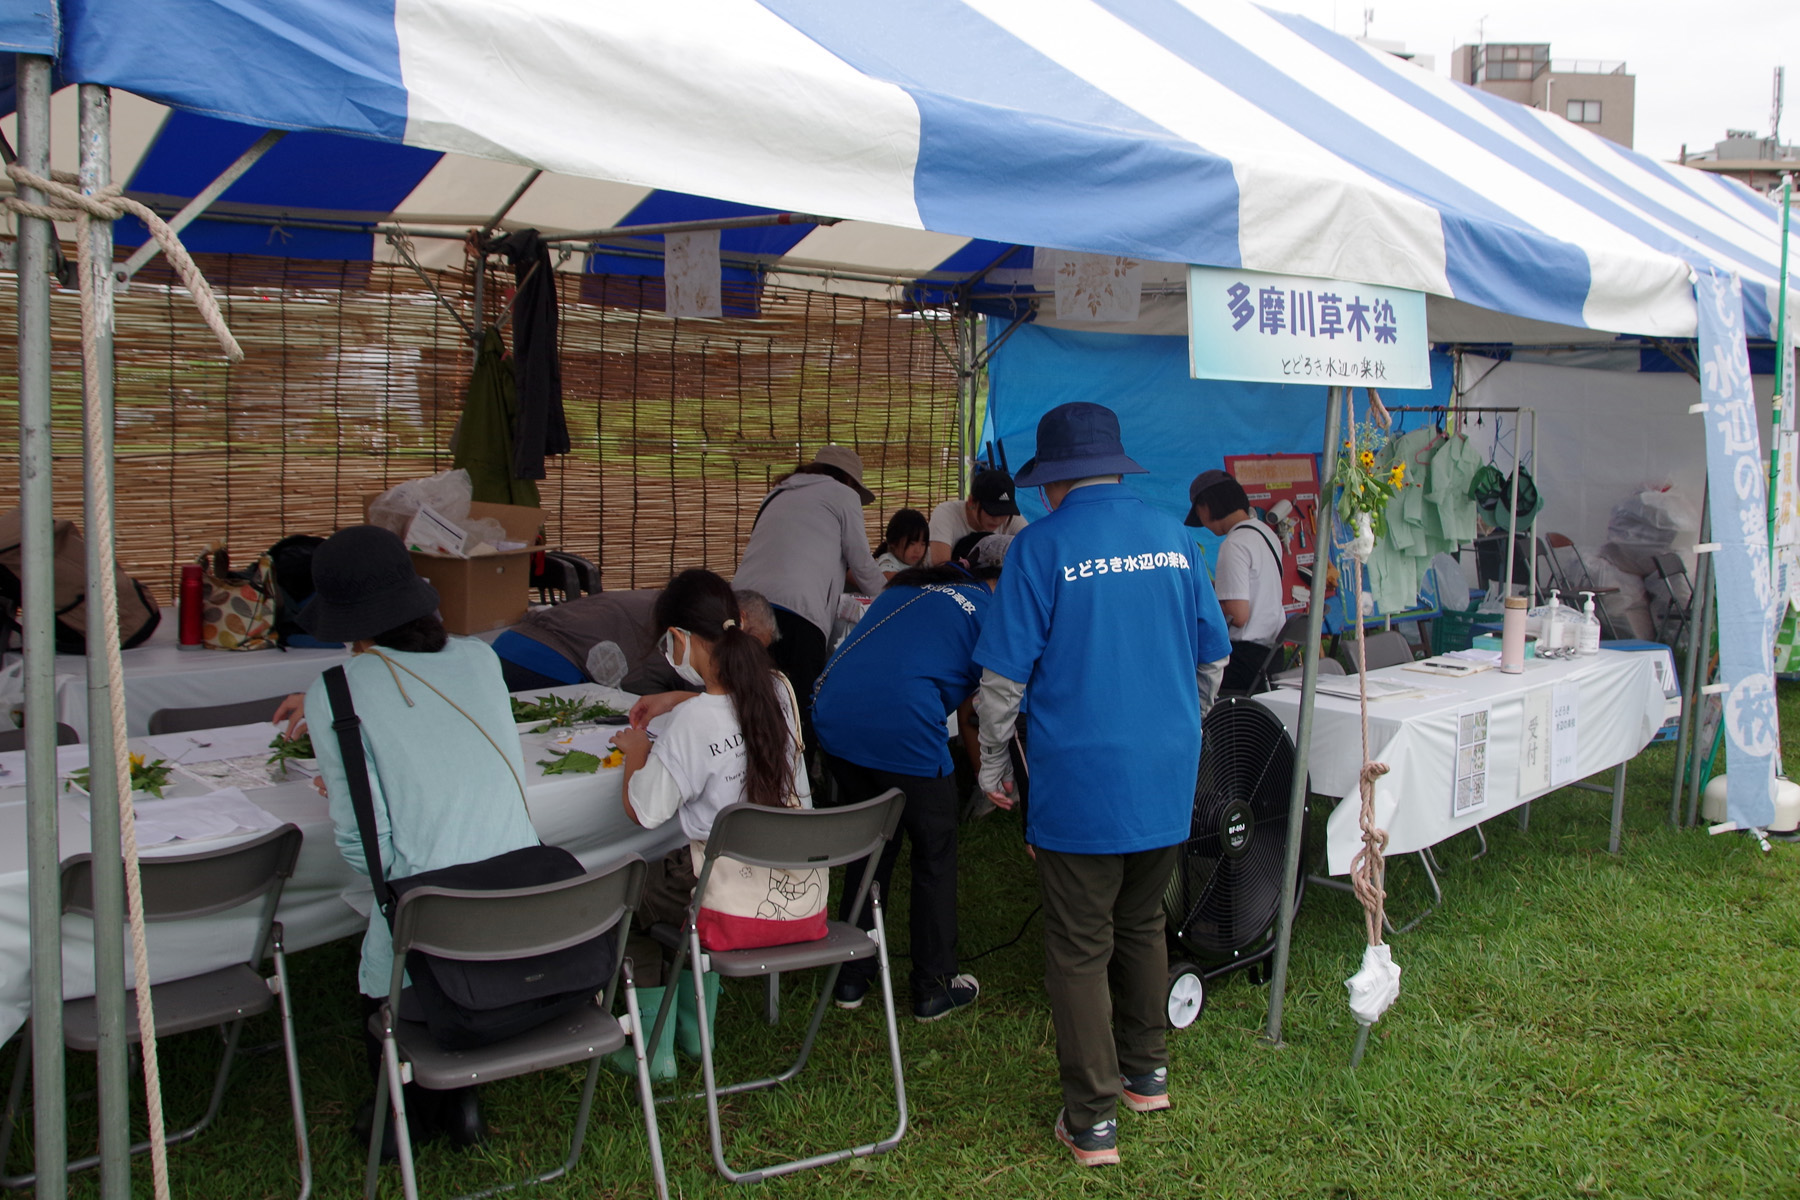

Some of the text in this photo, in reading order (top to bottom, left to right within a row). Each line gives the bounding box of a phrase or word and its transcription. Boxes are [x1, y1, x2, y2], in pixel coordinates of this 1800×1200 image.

[1226, 281, 1397, 344] 多摩川草木染
[1281, 353, 1388, 380] とどろき水辺の楽校
[1063, 551, 1190, 582] とどろき水辺の楽校
